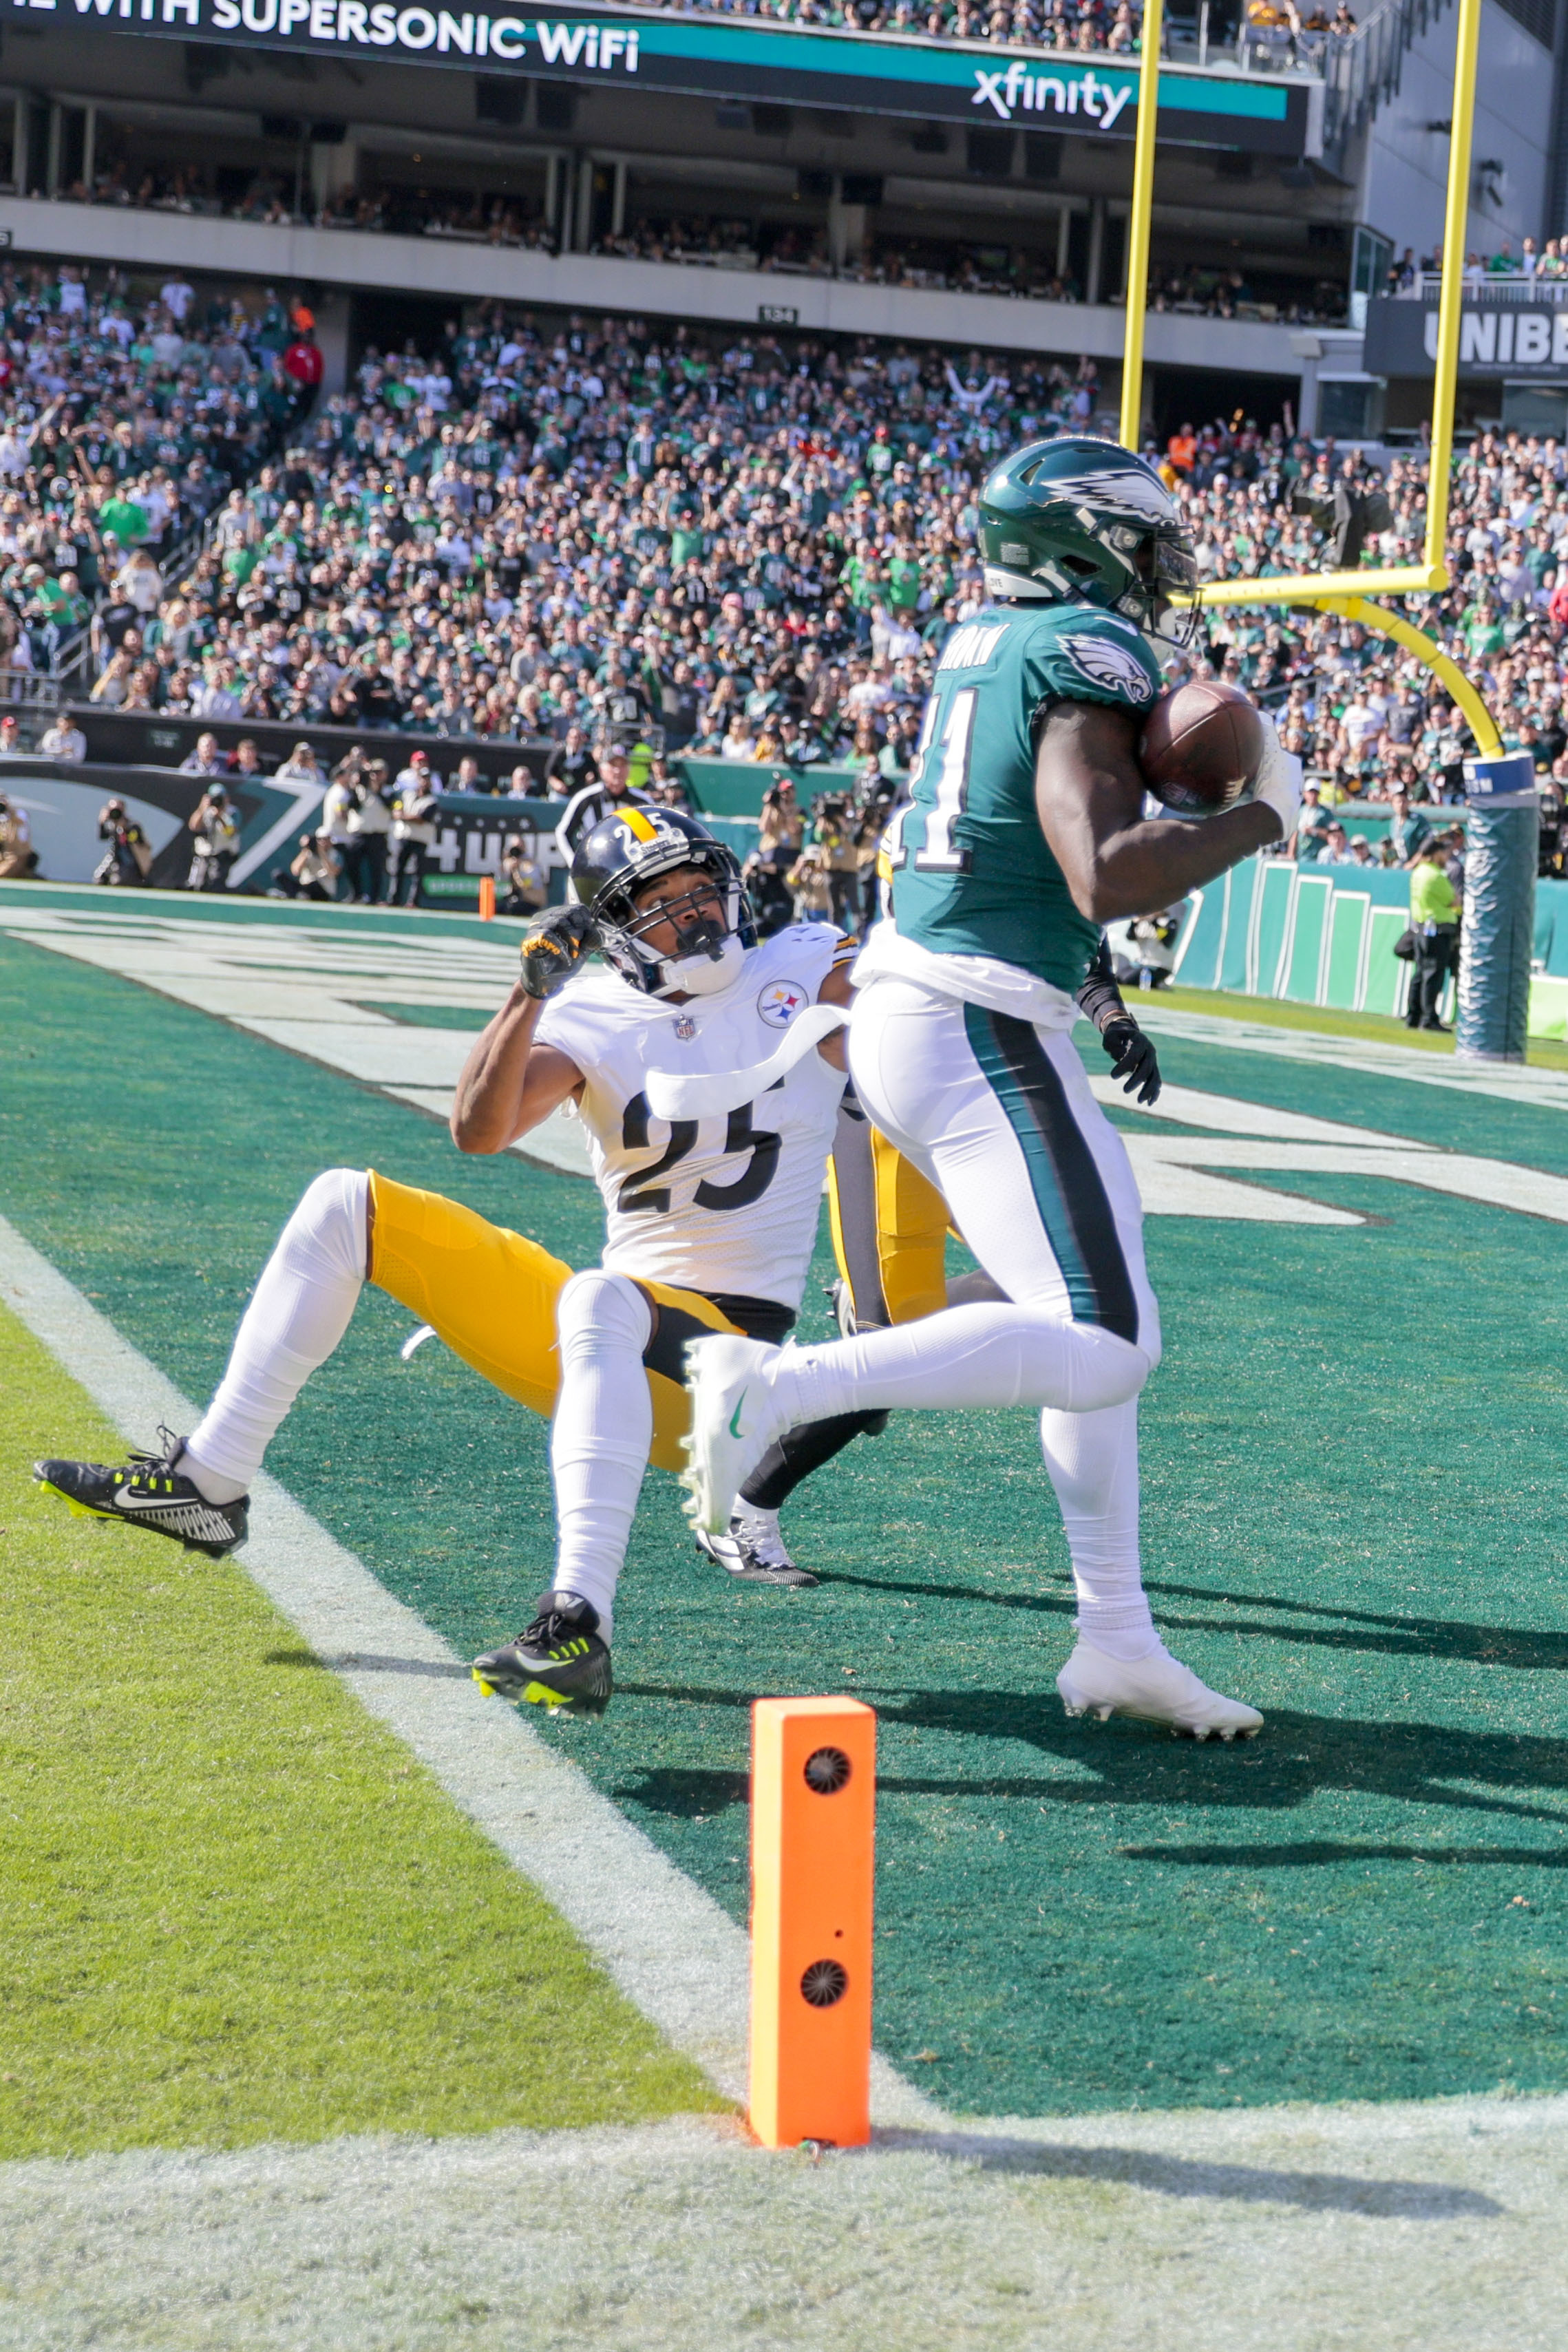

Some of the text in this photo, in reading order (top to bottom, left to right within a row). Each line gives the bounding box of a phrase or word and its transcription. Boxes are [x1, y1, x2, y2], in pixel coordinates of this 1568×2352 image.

[211, 0, 527, 59] SUPERSONIC
[536, 20, 639, 72] WiFi
[971, 61, 1133, 129] xfinity
[678, 1026, 694, 1036] NFL
[617, 1075, 785, 1211] 25
